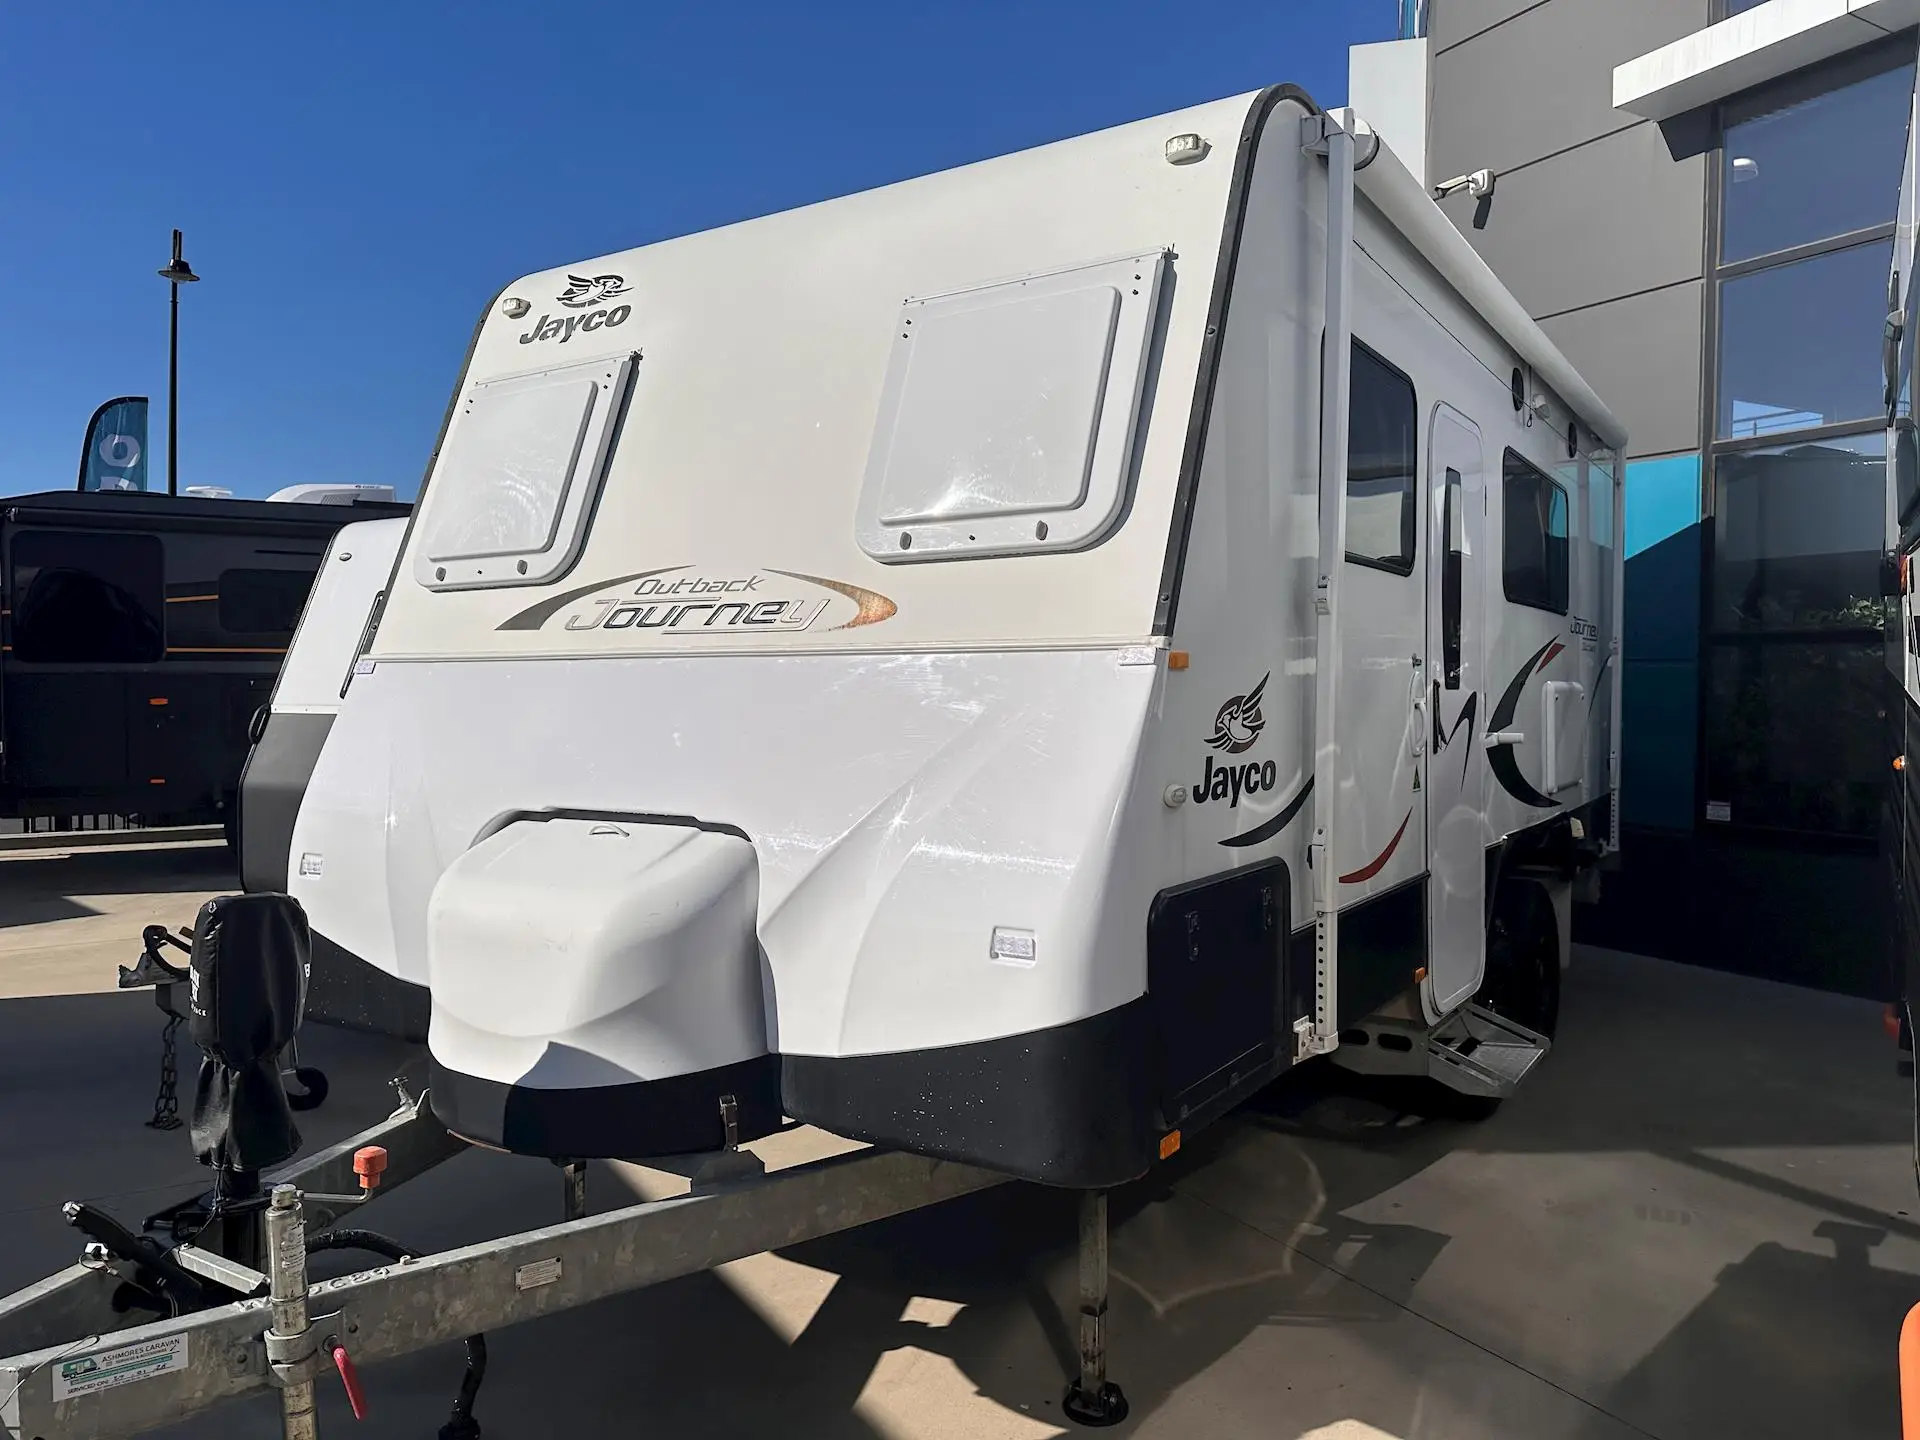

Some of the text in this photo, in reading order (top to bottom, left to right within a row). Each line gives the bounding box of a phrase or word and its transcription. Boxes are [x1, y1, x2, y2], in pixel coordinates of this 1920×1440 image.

[519, 304, 632, 345] Jayco
[634, 576, 765, 596] Outback
[564, 598, 831, 635] Journey
[1193, 755, 1276, 809] Jayco
[101, 1338, 180, 1362] ASHMORES CARAVAN
